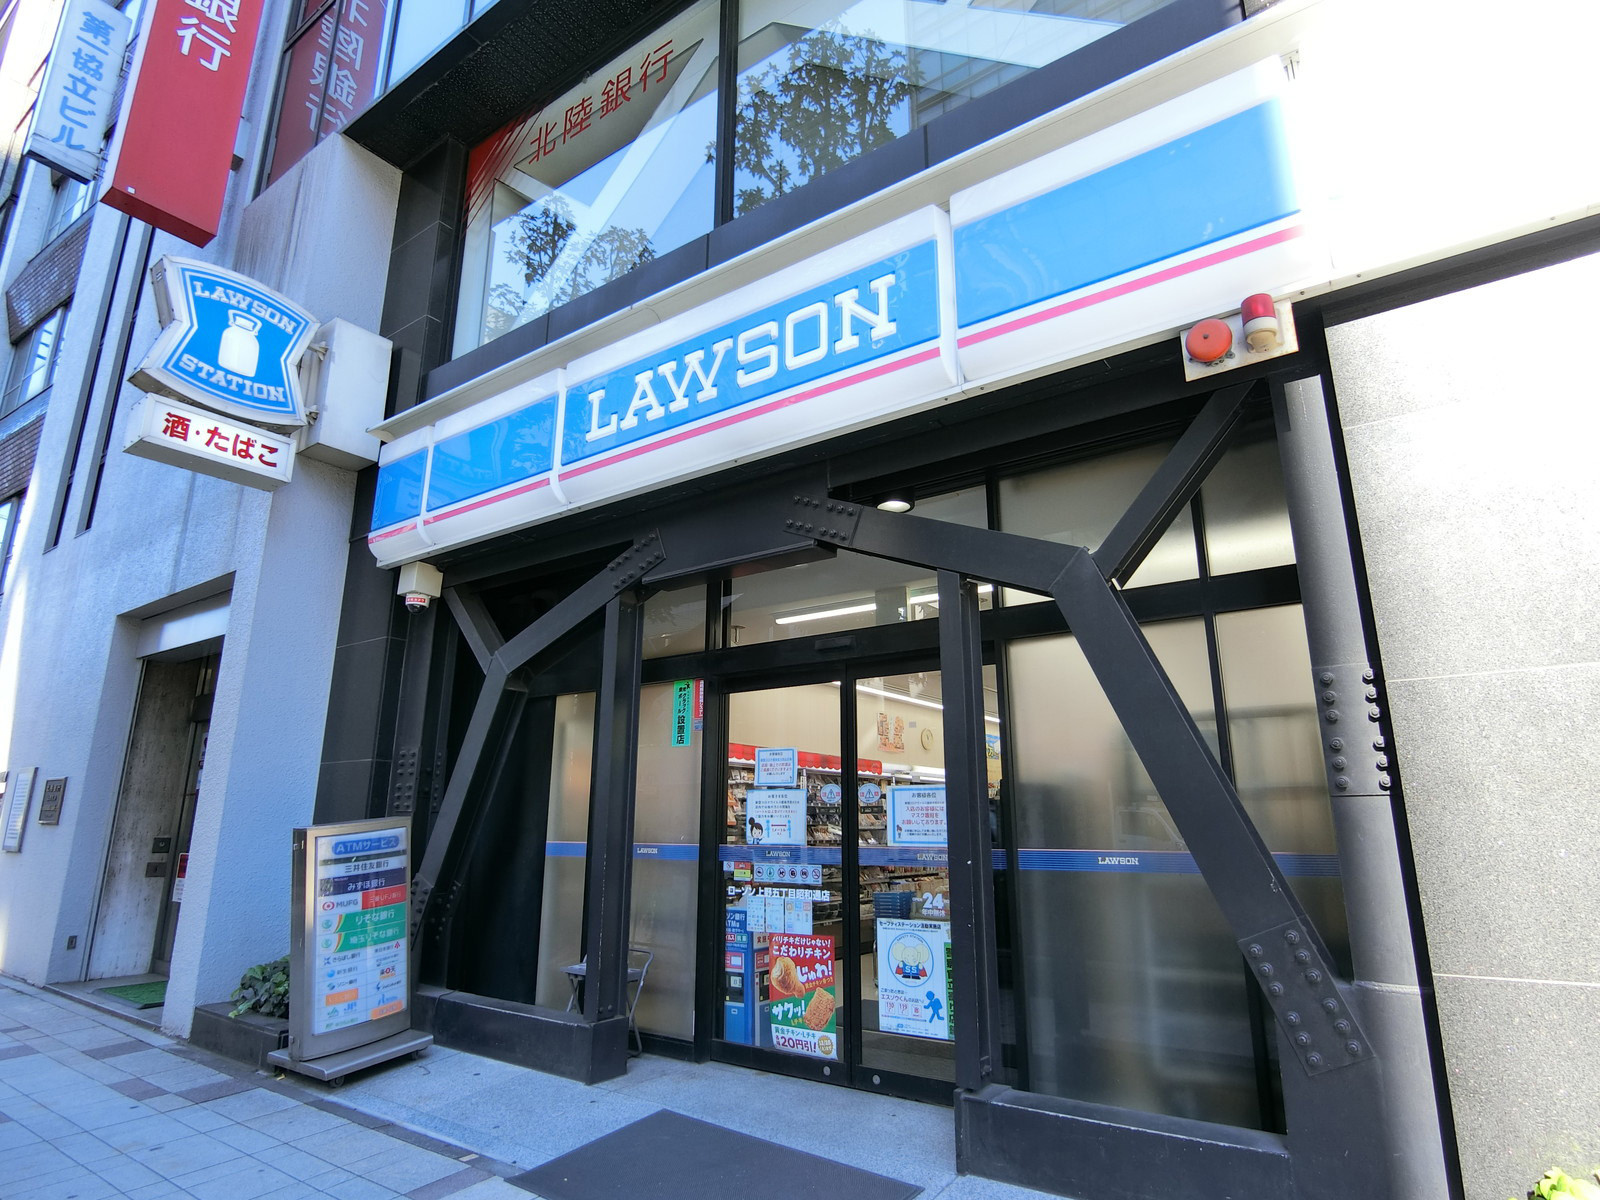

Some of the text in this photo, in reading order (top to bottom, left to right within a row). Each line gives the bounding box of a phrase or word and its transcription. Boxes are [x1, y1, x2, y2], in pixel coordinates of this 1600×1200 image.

[528, 39, 674, 165] 北陸銀行
[192, 280, 299, 336] LAWSON
[585, 273, 898, 443] LAWSON
[178, 352, 287, 403] STATION
[161, 411, 279, 468] 酒・たばこ
[336, 837, 397, 854] ATMサービス
[636, 847, 658, 855] LAWSON
[765, 850, 791, 858] LAWSON
[917, 853, 948, 861] LAWSON
[1098, 856, 1140, 865] LAWSON
[344, 860, 390, 874] 三井住友銀行
[347, 878, 386, 891] みずほ銀行
[336, 899, 358, 908] MUFG
[922, 892, 944, 909] 24
[355, 909, 395, 926] りそな銀行
[772, 944, 831, 960] こだわりチキン
[796, 960, 833, 983] じゅわ!
[771, 999, 806, 1020] サクッ!
[781, 1036, 817, 1053] 20円引!
